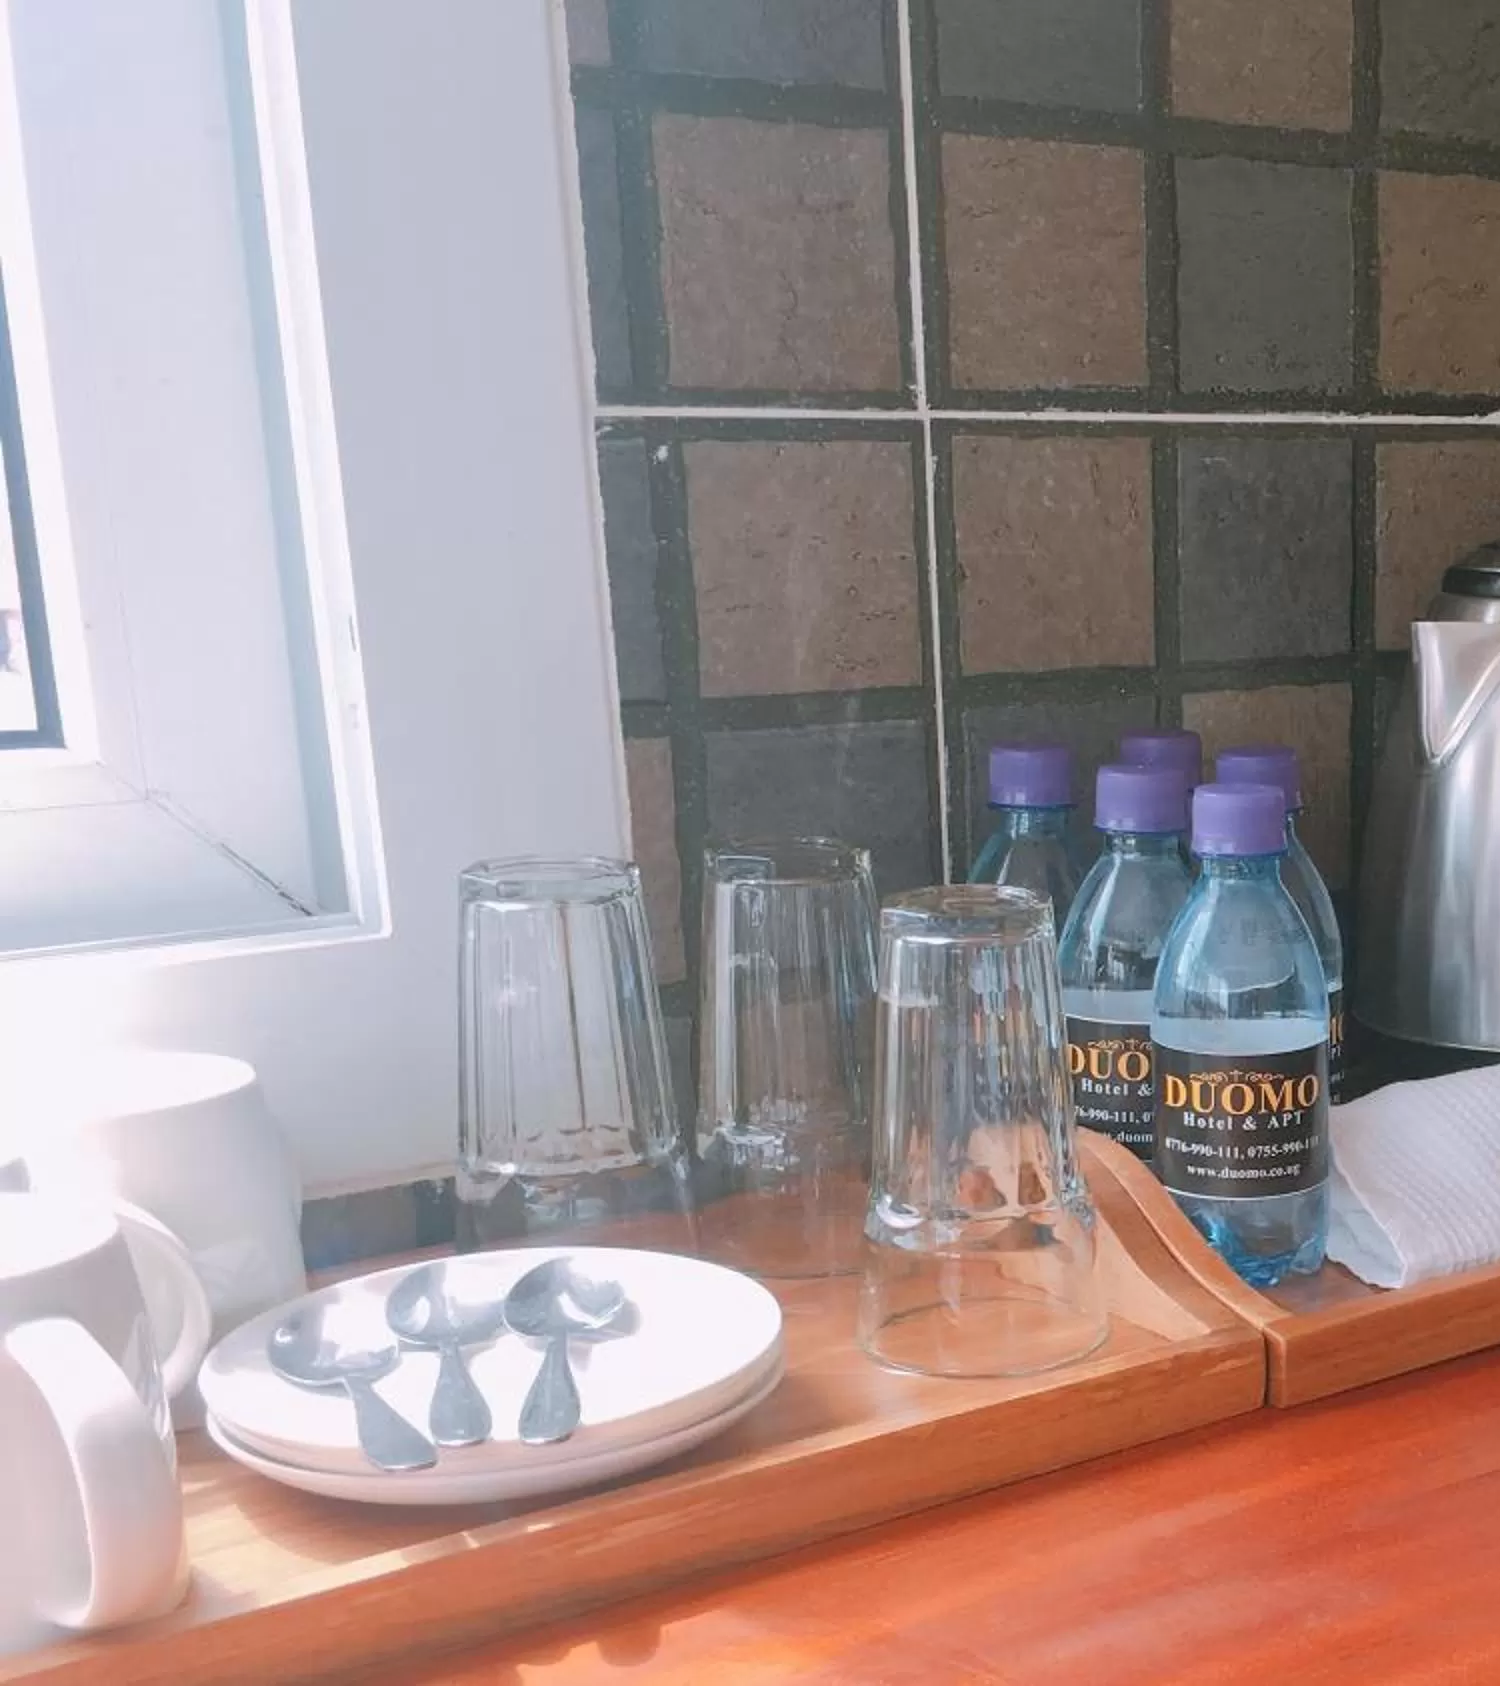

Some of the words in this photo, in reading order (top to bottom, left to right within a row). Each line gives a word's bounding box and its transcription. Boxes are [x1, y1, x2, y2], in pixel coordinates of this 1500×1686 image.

[1067, 1043, 1150, 1082] DUO
[1081, 1077, 1129, 1096] Hotel
[1164, 1072, 1319, 1116] DUOMO
[1074, 1105, 1140, 1124] 76-990-111,
[1183, 1111, 1233, 1131] Hotel
[1242, 1116, 1257, 1132] &
[1267, 1110, 1304, 1130] APT
